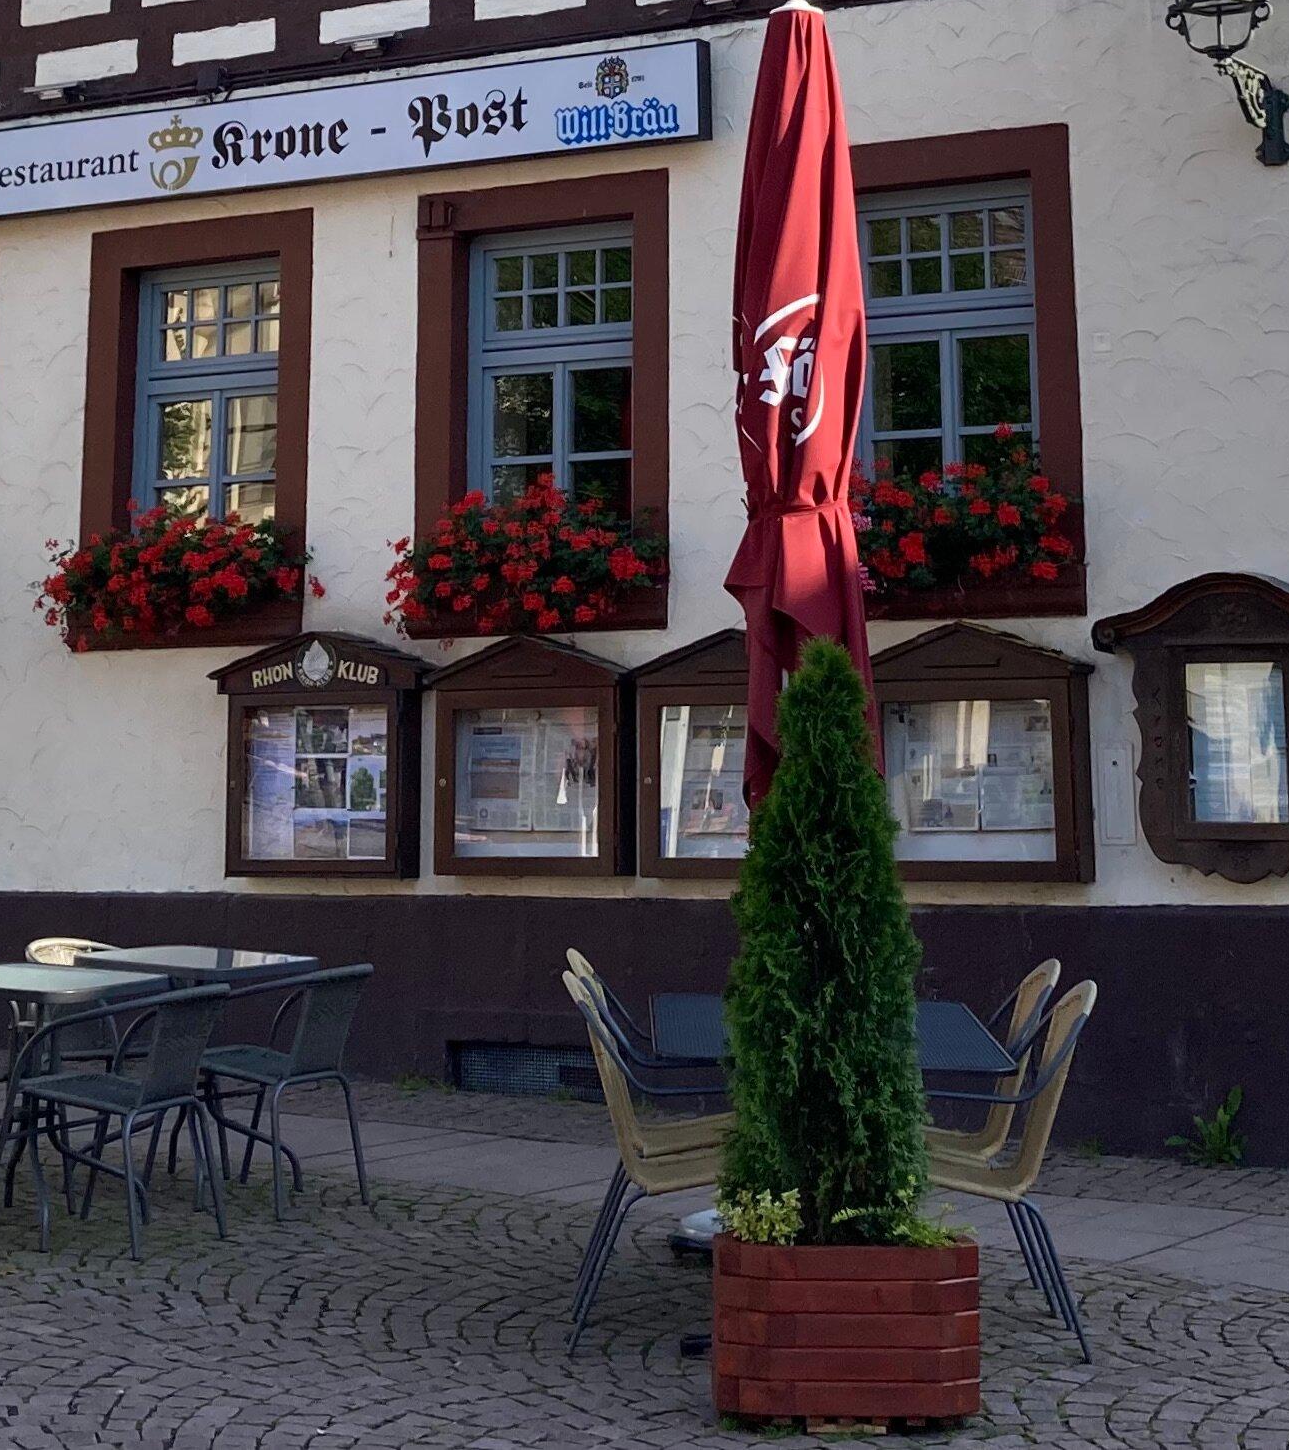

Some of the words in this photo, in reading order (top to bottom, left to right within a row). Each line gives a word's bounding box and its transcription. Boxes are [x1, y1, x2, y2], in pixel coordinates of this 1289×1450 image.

[211, 117, 349, 170] Krone
[407, 86, 529, 159] Post
[337, 659, 379, 685] KLUB
